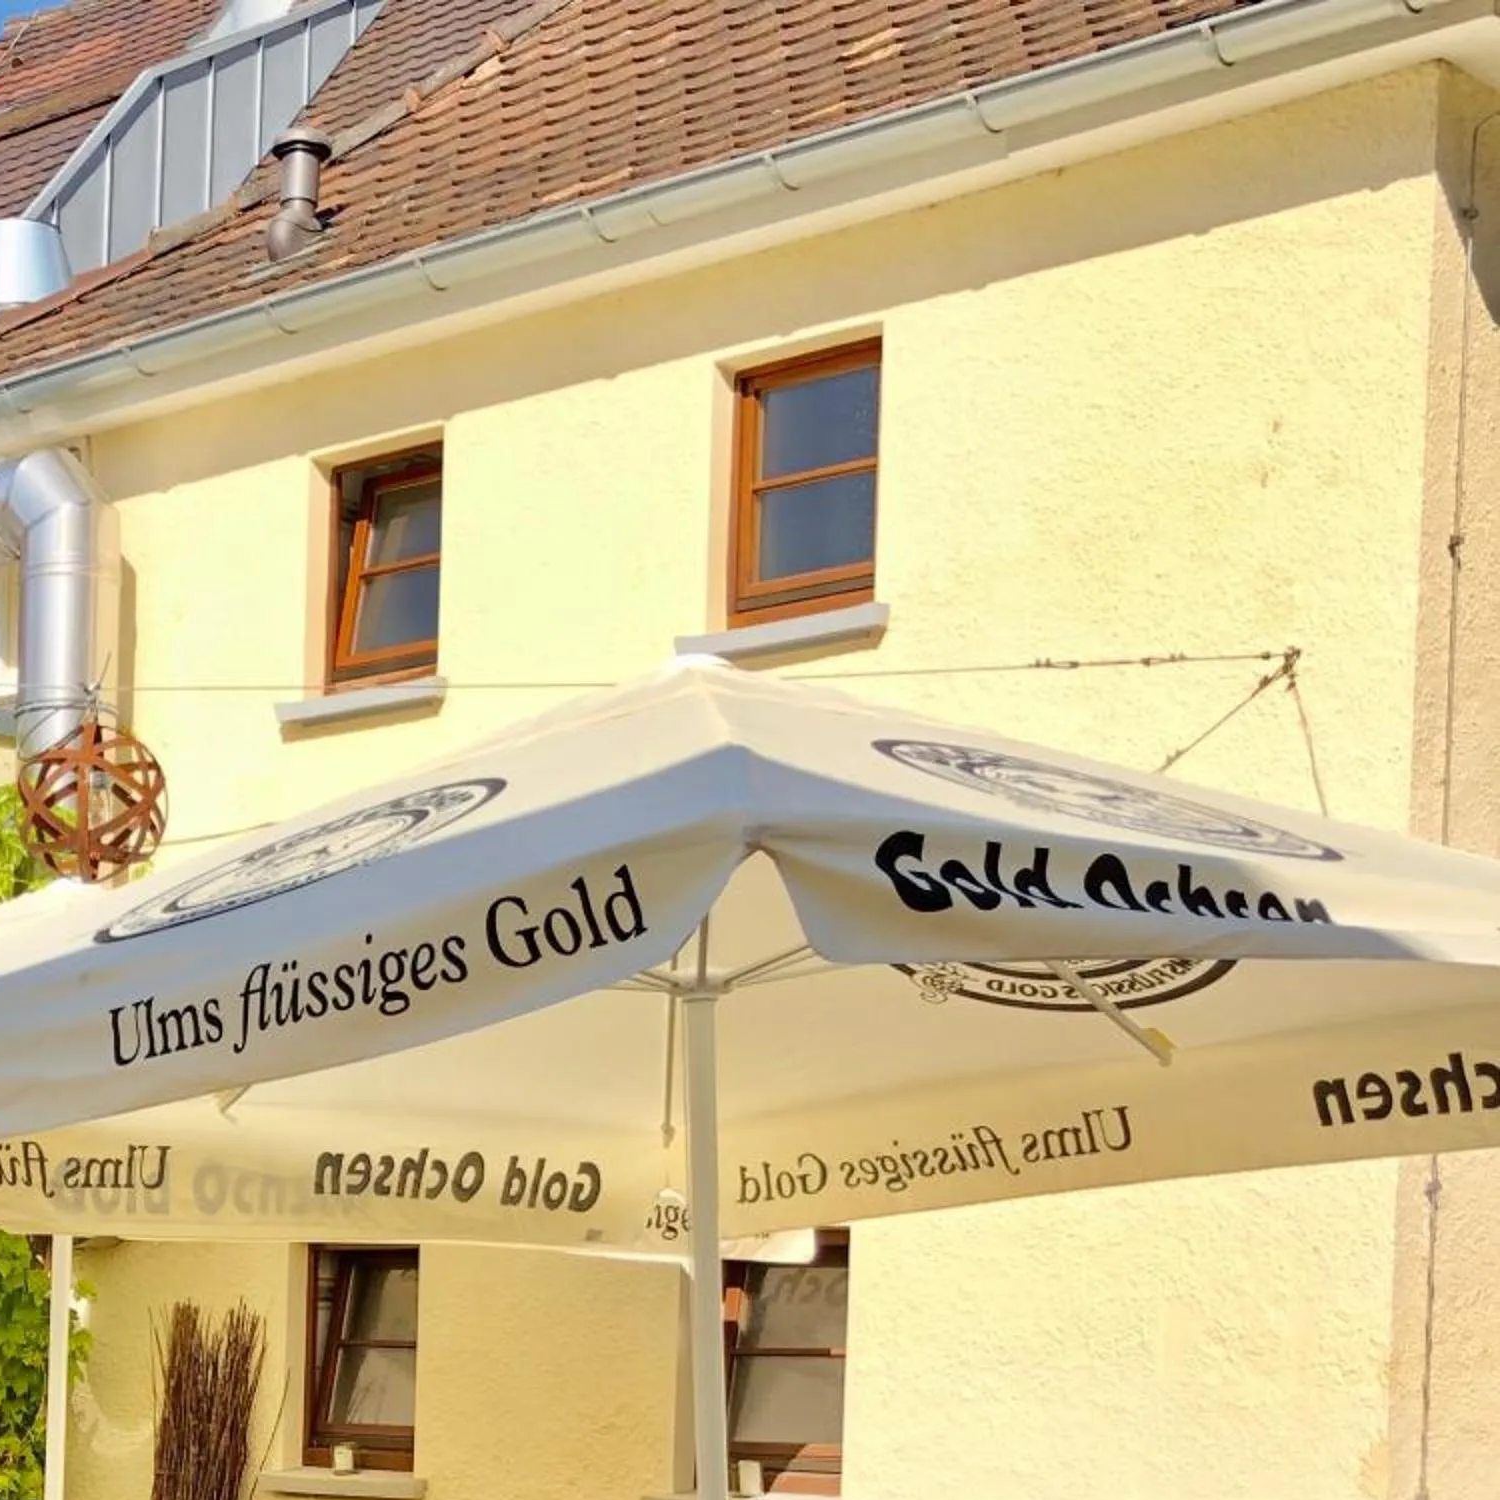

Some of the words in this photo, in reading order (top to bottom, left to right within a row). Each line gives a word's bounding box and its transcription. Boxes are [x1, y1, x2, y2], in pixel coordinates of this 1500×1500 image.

[875, 830, 1085, 913] Gold
[109, 993, 224, 1066] Ulms
[232, 932, 469, 1054] flüssiges
[484, 863, 649, 968] Gold
